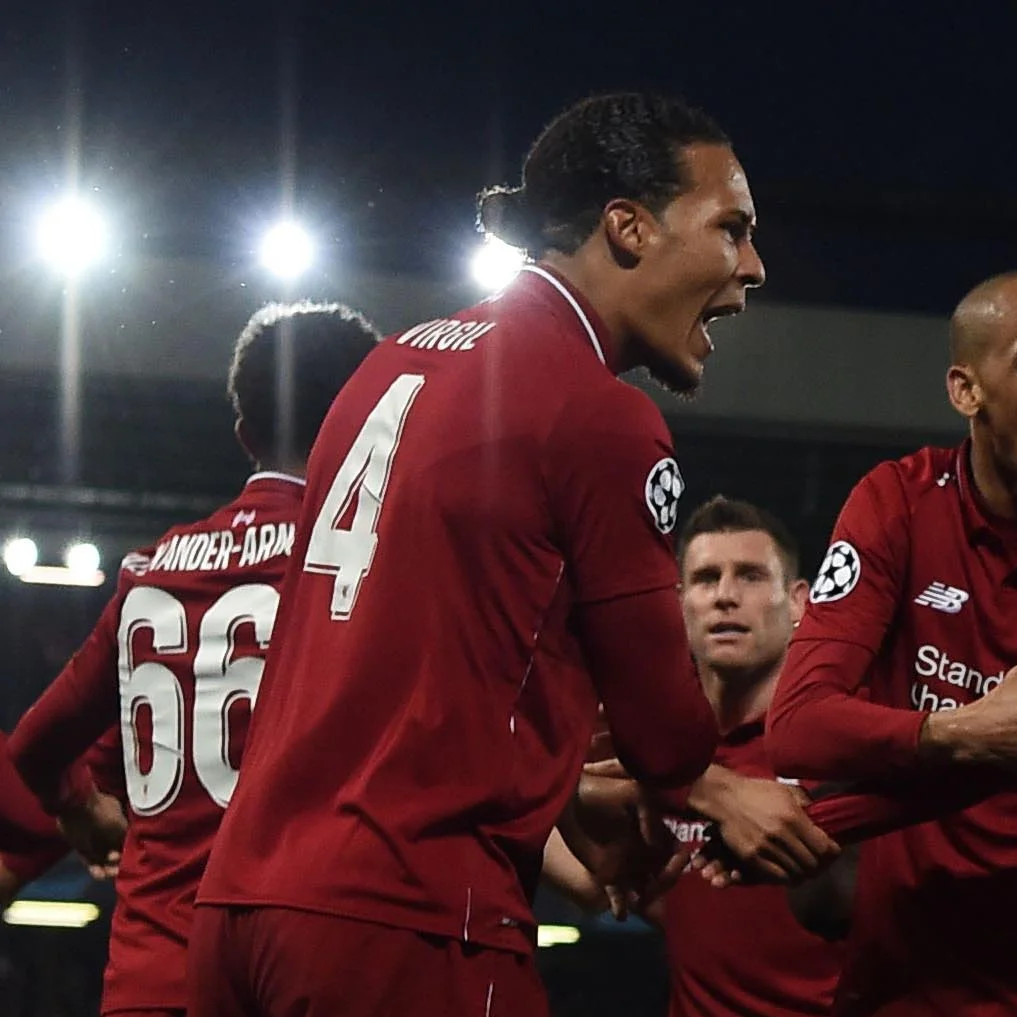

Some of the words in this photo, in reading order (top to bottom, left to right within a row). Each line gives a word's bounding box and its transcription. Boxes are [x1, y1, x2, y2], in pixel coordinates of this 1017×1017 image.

[396, 319, 497, 351] VIRGIL
[303, 374, 425, 621] 4
[117, 583, 281, 817] 66
